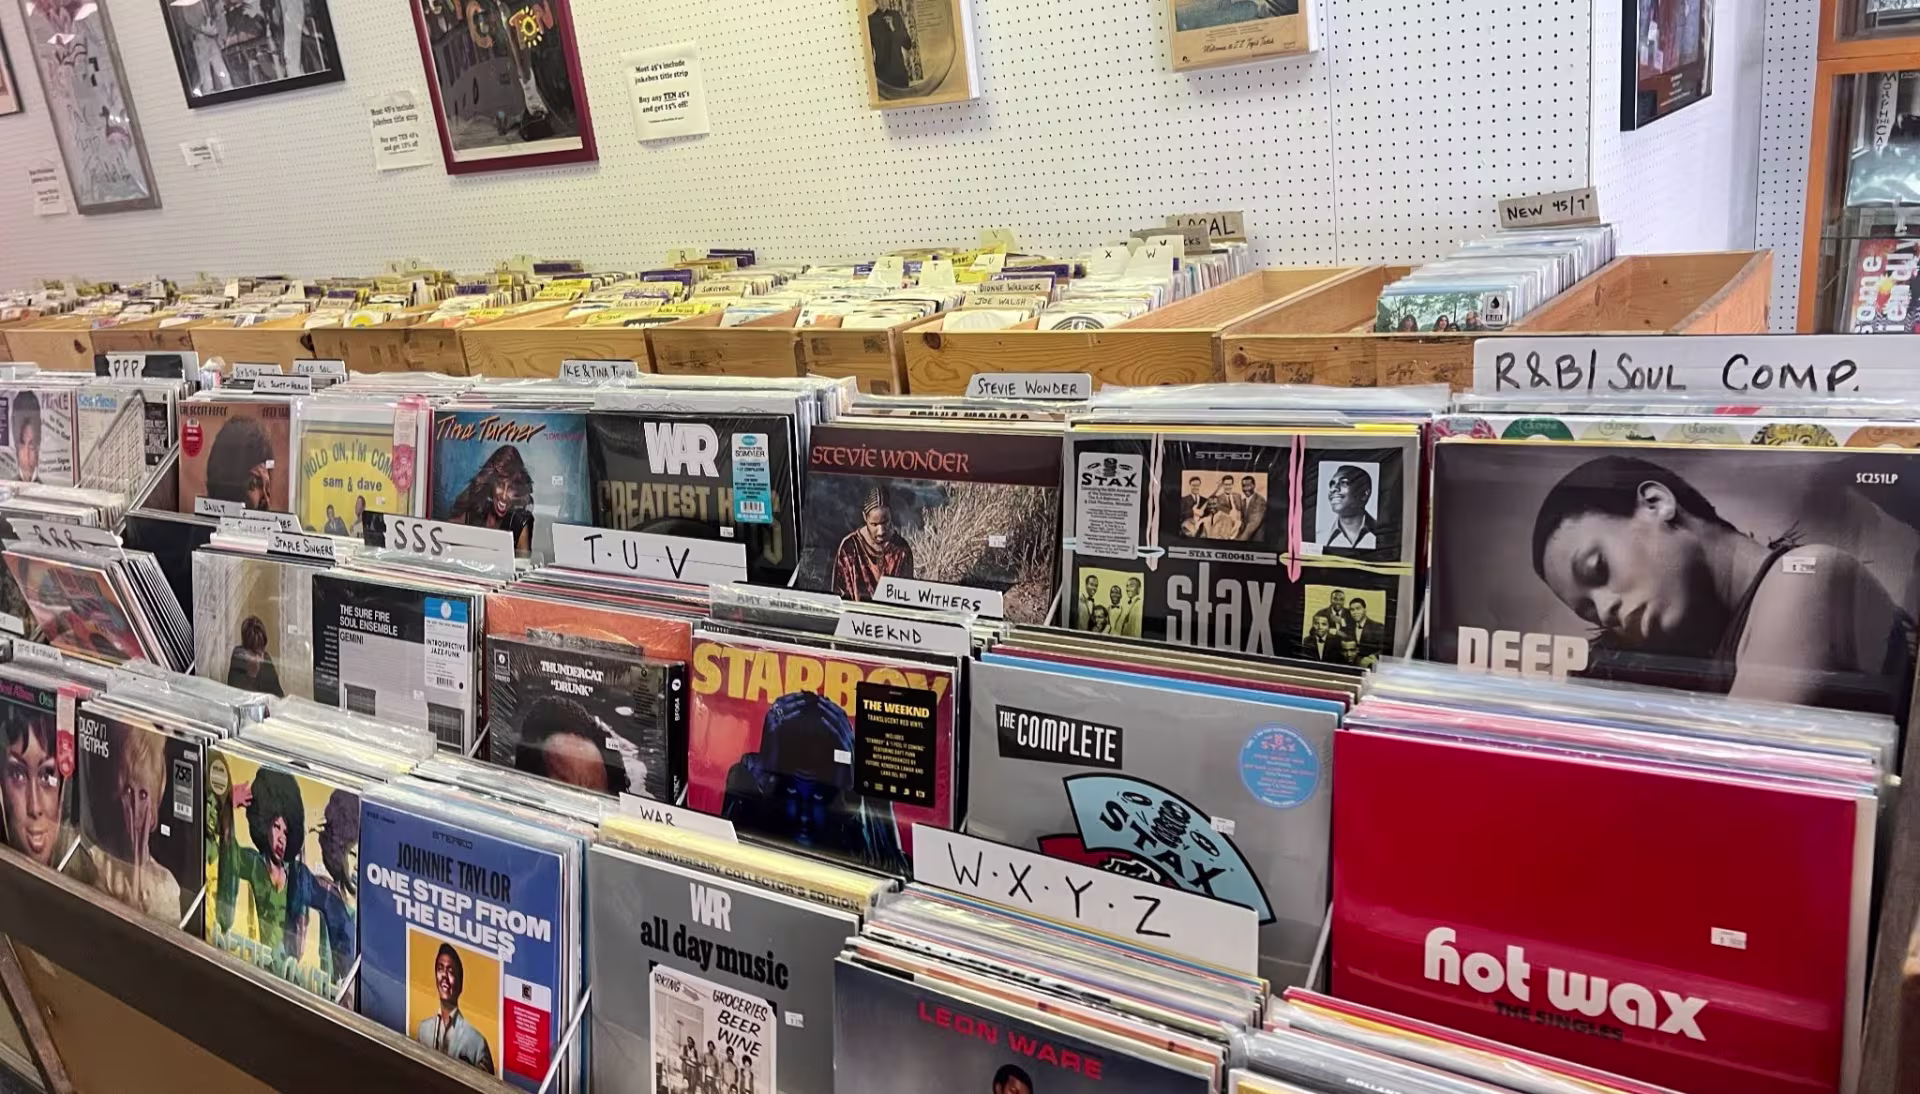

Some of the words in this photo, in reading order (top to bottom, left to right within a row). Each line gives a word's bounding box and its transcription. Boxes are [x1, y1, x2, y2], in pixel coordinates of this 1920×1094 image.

[663, 60, 685, 69] include
[674, 70, 689, 78] strip
[651, 95, 662, 103] any
[663, 91, 677, 100] TEN
[678, 90, 690, 98] 45's
[642, 105, 653, 113] and
[654, 104, 664, 112] get
[1507, 204, 1543, 219] NEW
[1104, 250, 1113, 259] X
[1146, 249, 1156, 258] W
[980, 283, 1003, 293] DIONNE
[1007, 283, 1041, 292] WARWICK
[564, 364, 580, 378] IKE
[592, 366, 610, 379] TINA
[978, 378, 1016, 395] STEVIE
[1025, 379, 1078, 395] WONDER
[436, 414, 477, 442] Tina
[479, 415, 547, 443] Turner
[643, 421, 720, 478] WAR
[1195, 451, 1252, 460] STEREO
[304, 449, 328, 479] HOLD
[881, 448, 969, 473] WONDER
[323, 477, 343, 488] sam
[347, 476, 353, 492] &
[357, 477, 382, 492] dave
[1081, 472, 1138, 488] STAX
[1855, 472, 1899, 486] SC251LP
[203, 500, 226, 513] SAULT
[274, 536, 300, 553] STAPLE
[304, 539, 333, 556] SINGERS
[1189, 550, 1212, 558] STAX
[886, 583, 911, 602] BILL
[918, 588, 981, 612] WITHERS
[340, 604, 353, 616] THE
[354, 607, 373, 620] SURE
[375, 610, 390, 623] FIRE
[1166, 562, 1276, 656] stax
[340, 616, 358, 628] SOUL
[360, 620, 398, 636] ENSEMBLE
[851, 619, 922, 644] WEEKND
[340, 631, 364, 645] GEMINI
[426, 639, 465, 652] INTROSPECTIVE
[1458, 625, 1589, 678] DEEP
[540, 660, 604, 682] THUNDERCAT
[551, 680, 593, 696] "DRUNK"
[863, 699, 882, 711] THE
[884, 702, 930, 718] WEEKND
[80, 716, 99, 737] DUSTY
[867, 714, 899, 725] TRANSLUCENT
[910, 721, 924, 729] VINYL
[79, 733, 109, 758] MEMPHIS
[999, 711, 1016, 729] THE
[1017, 713, 1117, 763] COMPLETE
[640, 806, 675, 826] WAR
[1100, 801, 1226, 896] STAX
[397, 841, 454, 885] JOHNNIE
[457, 860, 511, 903] TAYLOR
[647, 848, 722, 875] ANNIVERSARY
[725, 867, 805, 896] COLLECTOR'S
[810, 889, 860, 911] EDITION
[367, 863, 411, 896] ONE
[413, 879, 472, 915] STEP
[476, 900, 551, 942] FROM
[690, 882, 732, 932] WAR
[392, 894, 434, 927] THE
[438, 909, 515, 956] BLUES
[641, 916, 668, 951] all
[673, 925, 713, 973] day
[716, 947, 789, 990] music
[1424, 927, 1530, 1001] hot
[1547, 968, 1709, 1041] wax
[713, 990, 768, 1022] GROCERIES
[718, 1010, 761, 1037] BEER
[1495, 1001, 1530, 1021] THE
[1535, 1010, 1624, 1041] SINGLES
[718, 1027, 762, 1057] WINE
[918, 1001, 997, 1044] LEON
[1008, 1031, 1104, 1081] WARE
